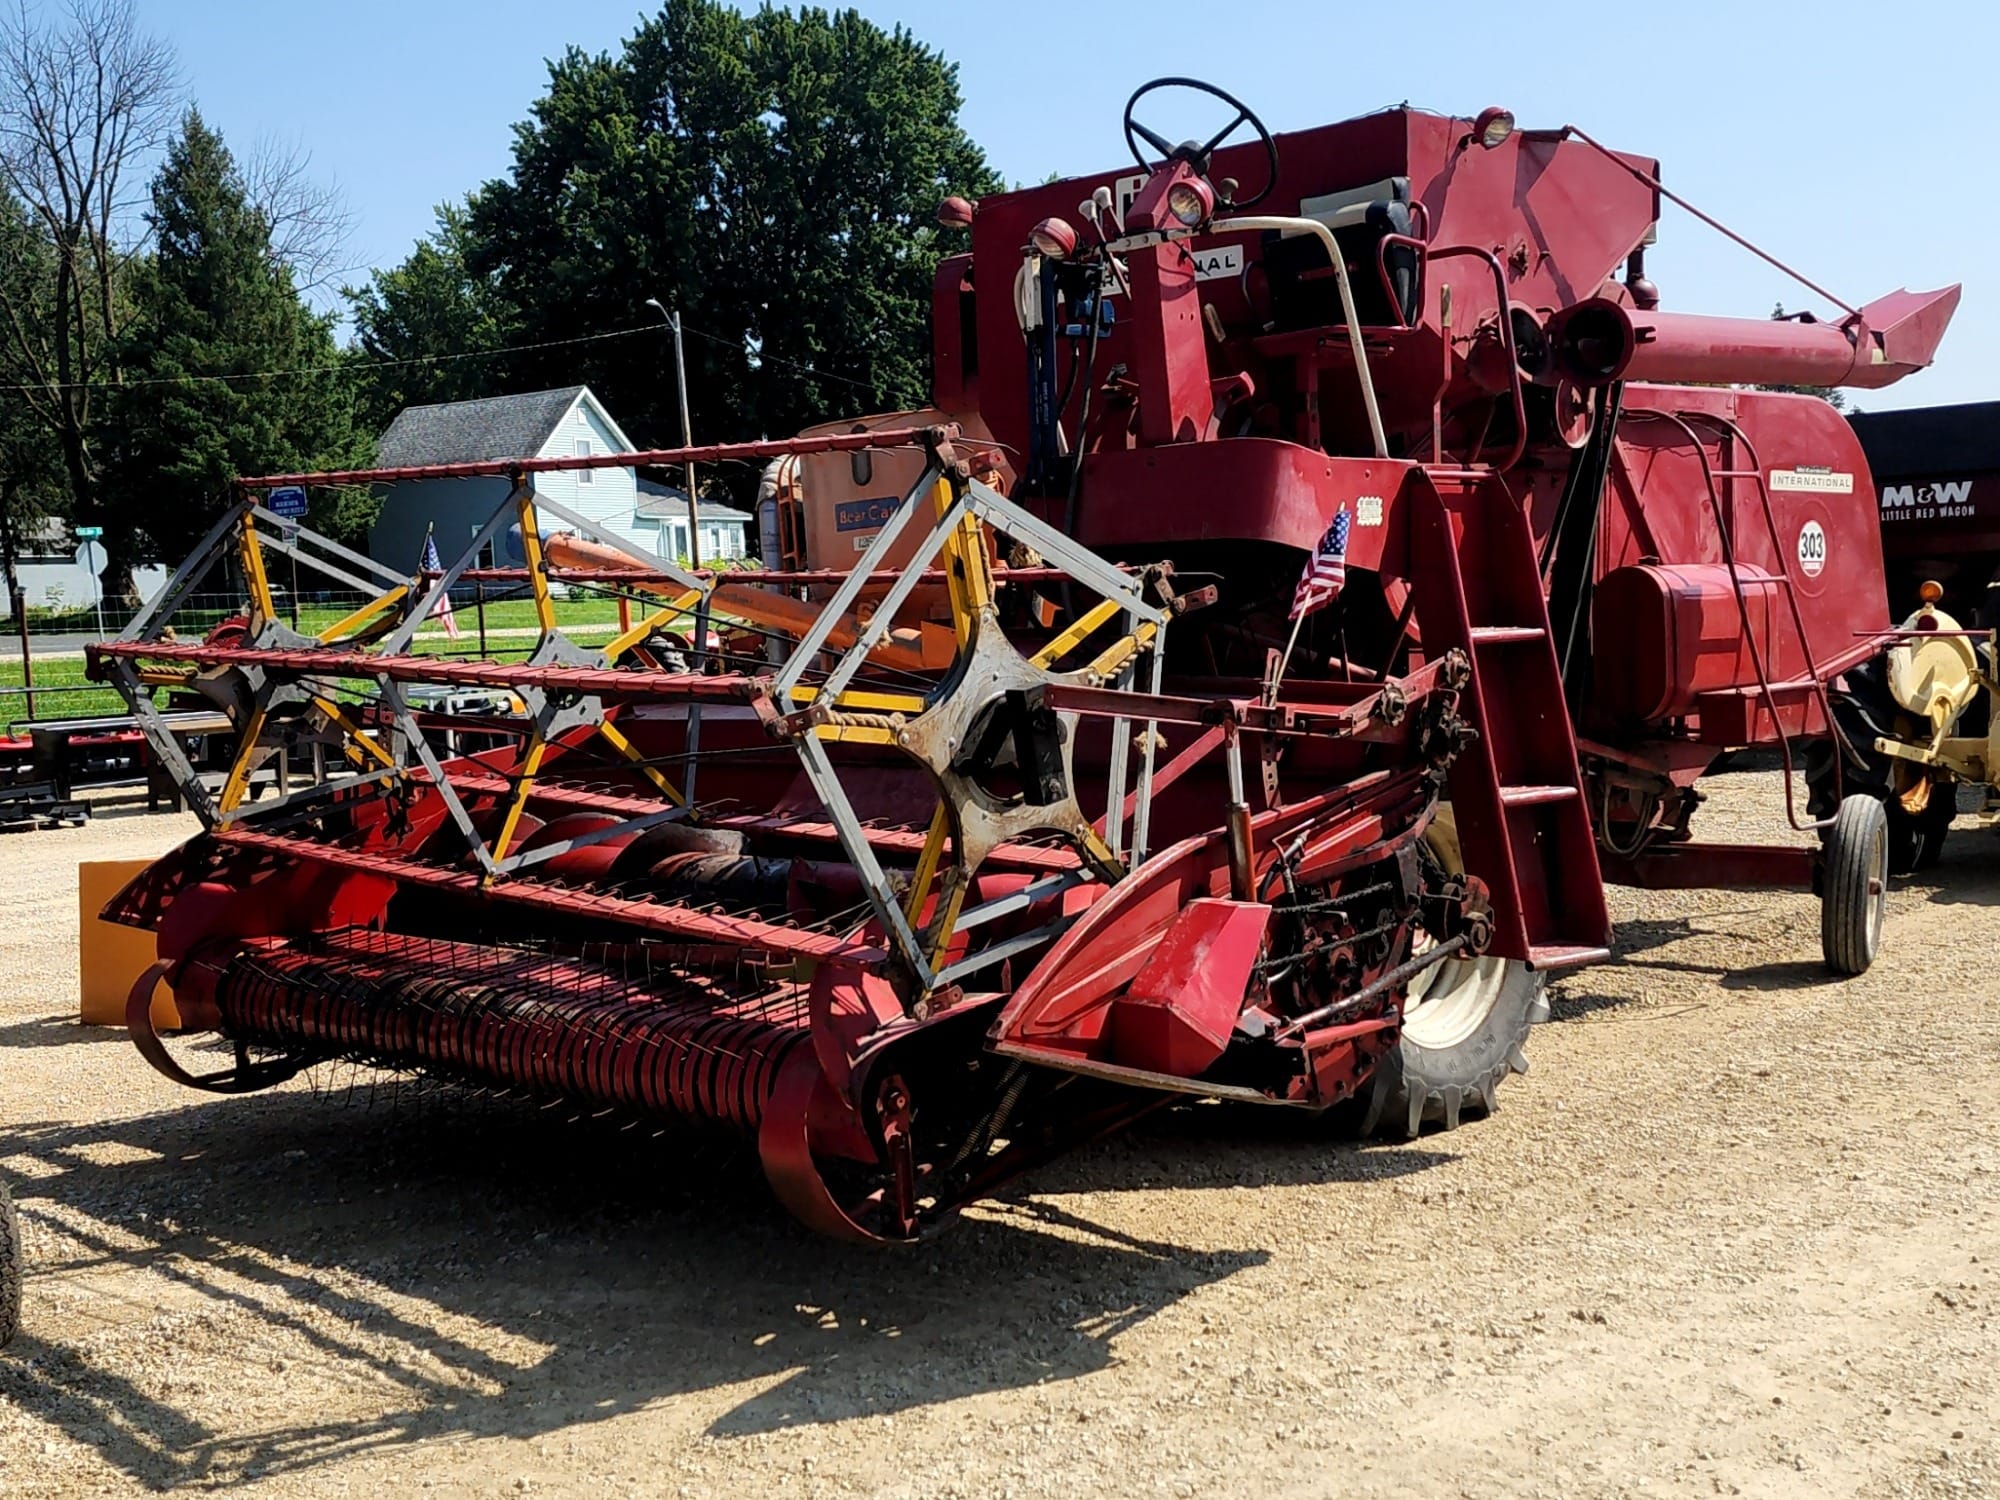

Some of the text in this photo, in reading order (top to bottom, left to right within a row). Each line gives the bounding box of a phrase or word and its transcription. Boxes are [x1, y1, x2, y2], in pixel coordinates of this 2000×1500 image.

[1773, 475, 1850, 488] INTERNATIONAL
[1881, 481, 1973, 507] M&W
[840, 510, 865, 524] Bear
[1881, 505, 1975, 521] LITTLE RED WAGON
[1801, 532, 1823, 559] 303
